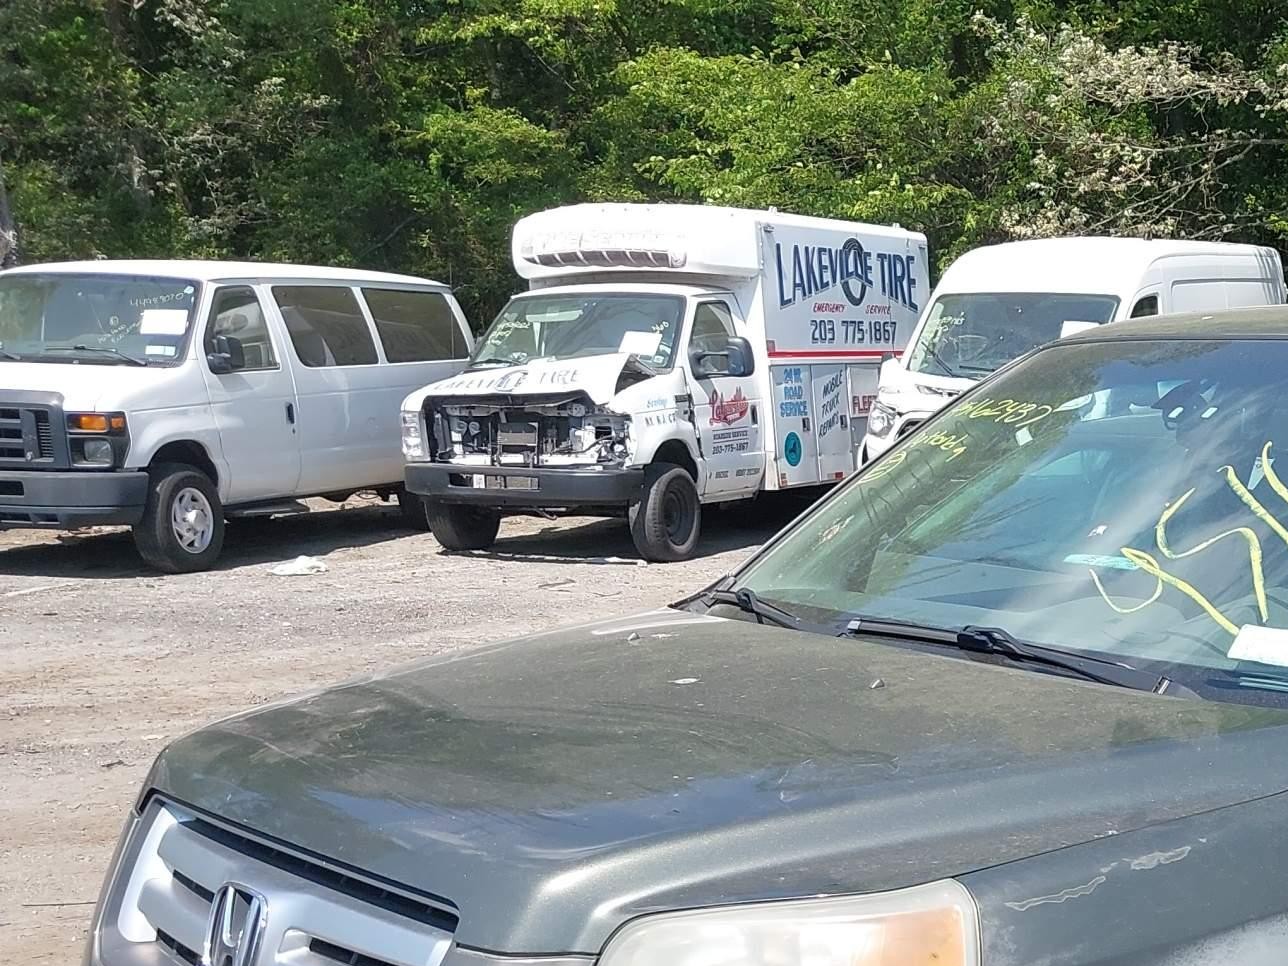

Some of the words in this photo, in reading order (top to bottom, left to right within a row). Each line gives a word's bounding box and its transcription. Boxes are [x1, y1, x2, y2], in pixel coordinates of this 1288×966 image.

[776, 242, 874, 309] LAKEVILLE
[877, 253, 919, 313] TIRE
[813, 302, 846, 313] EMERGENCY
[865, 304, 892, 315] SERVICE
[810, 320, 835, 344] 203
[784, 386, 803, 400] ROAD
[823, 369, 843, 398] MOBILE
[780, 401, 808, 417] SERVICE
